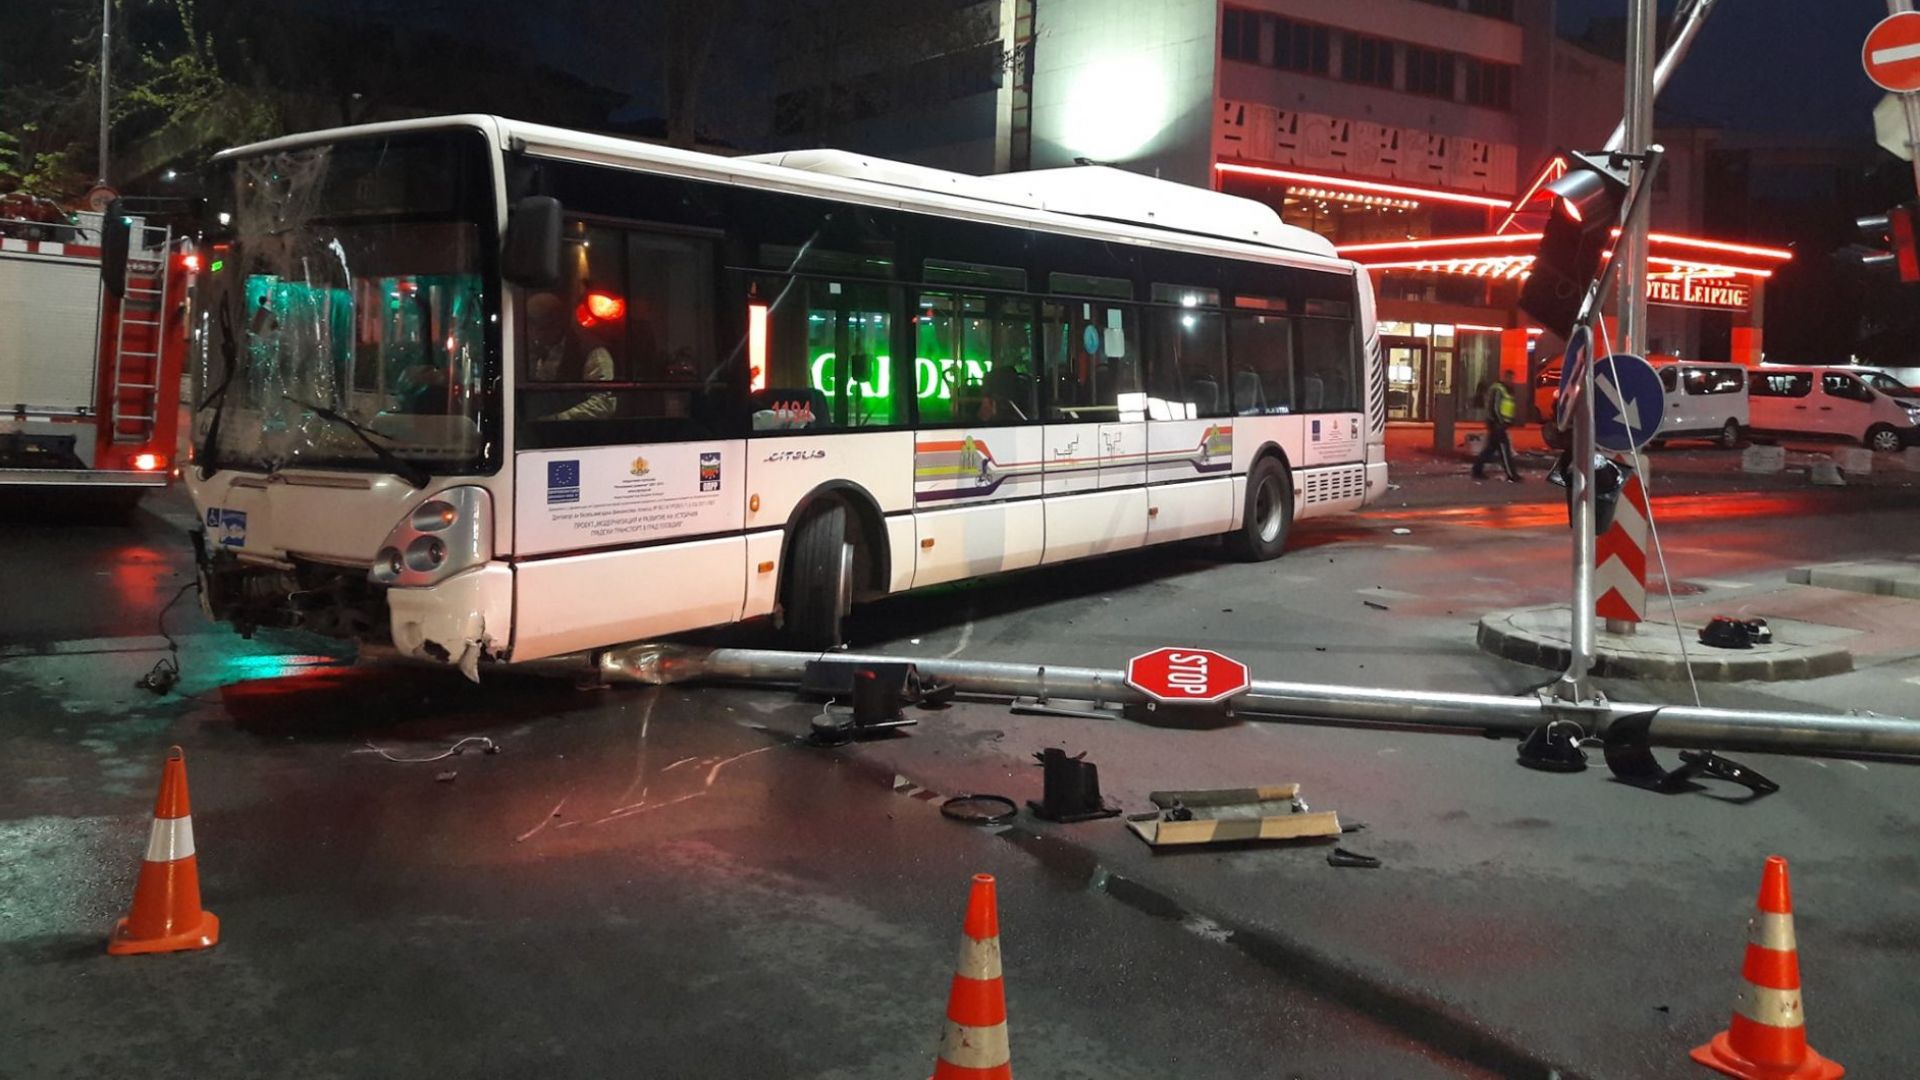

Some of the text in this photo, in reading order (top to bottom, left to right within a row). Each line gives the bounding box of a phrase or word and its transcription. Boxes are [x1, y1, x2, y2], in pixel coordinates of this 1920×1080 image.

[1646, 275, 1743, 306] OTEL LEIPZIG
[1167, 653, 1208, 694] STOP
